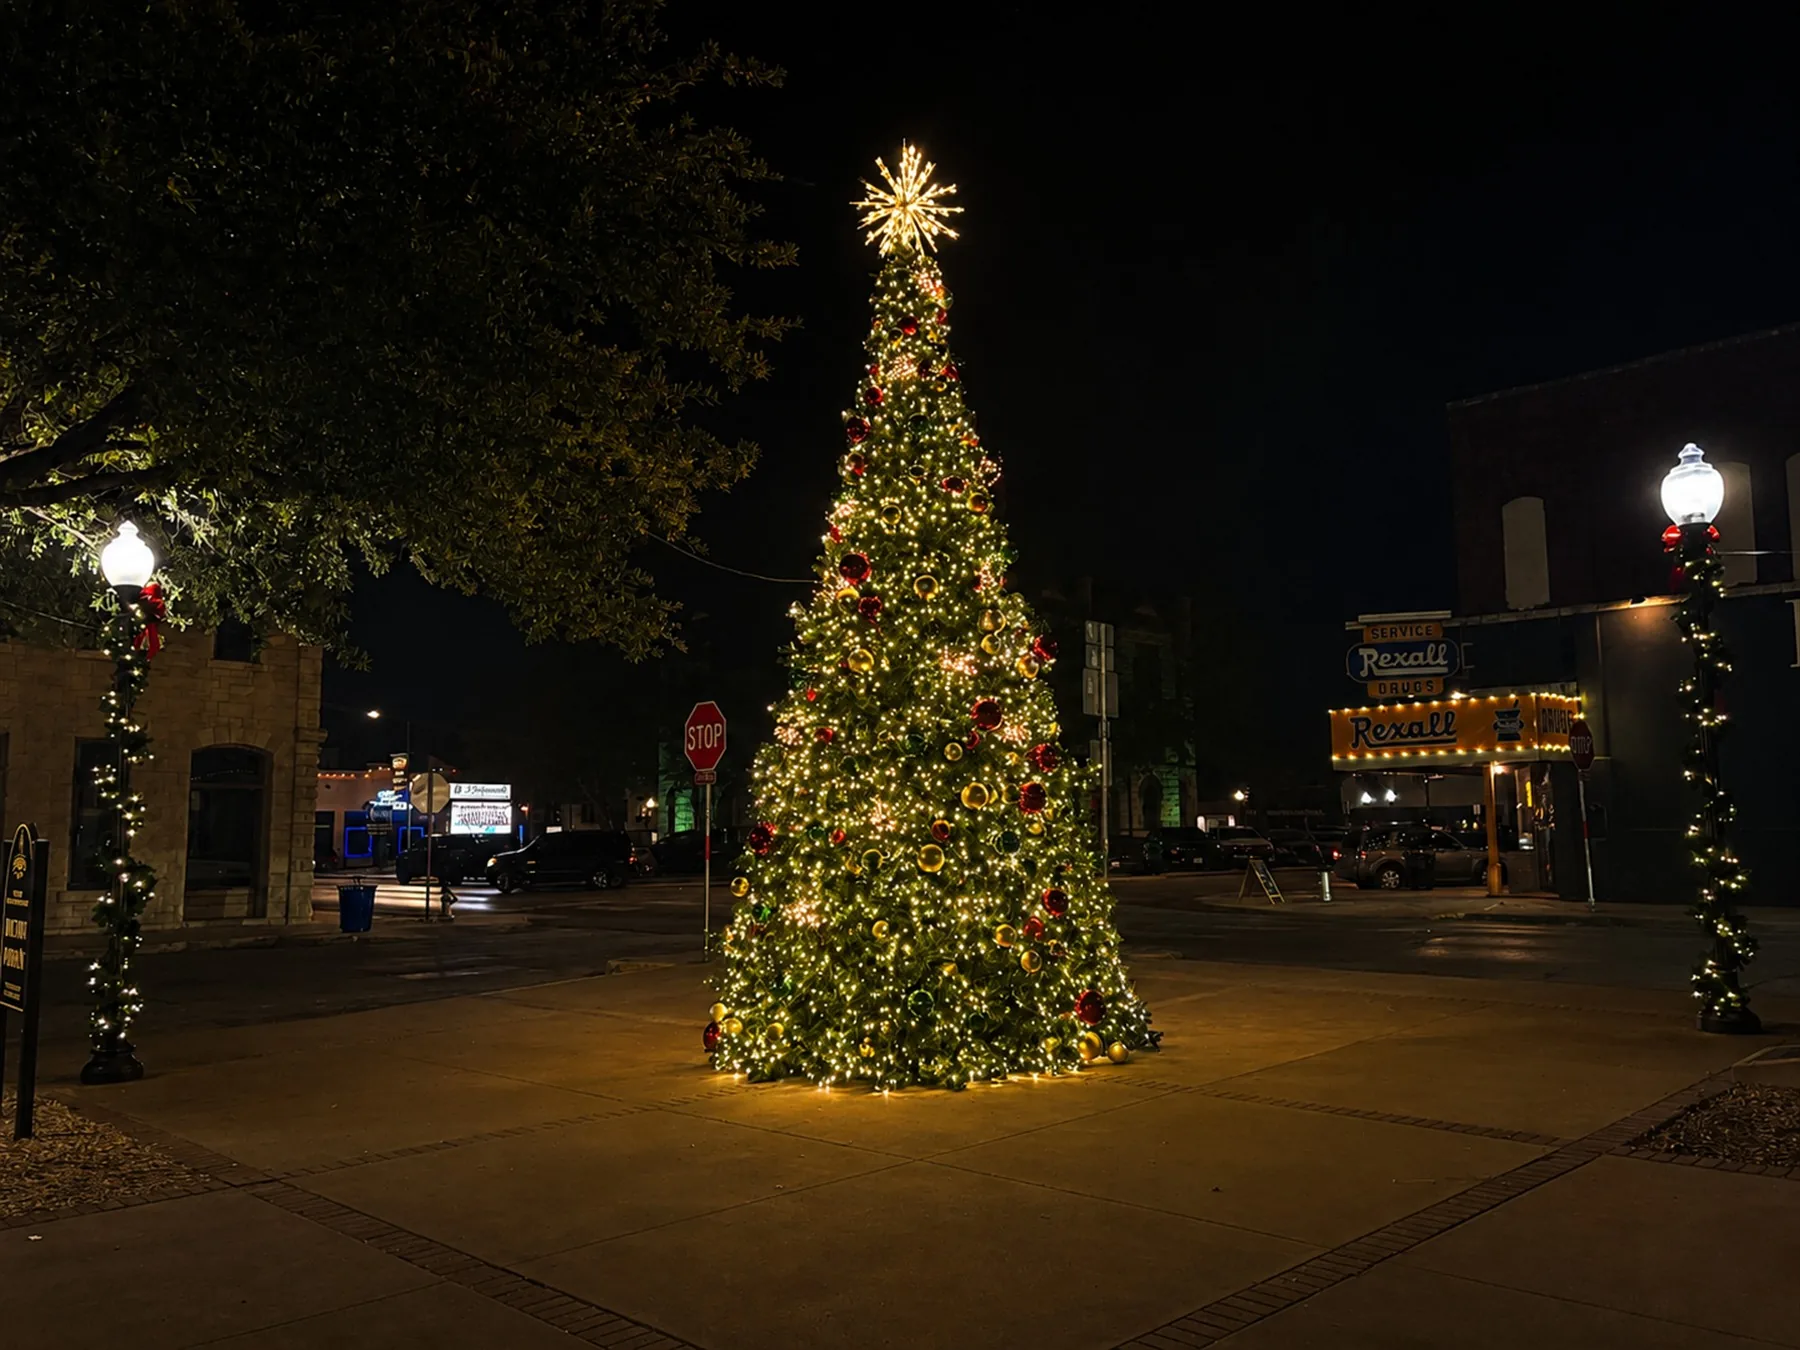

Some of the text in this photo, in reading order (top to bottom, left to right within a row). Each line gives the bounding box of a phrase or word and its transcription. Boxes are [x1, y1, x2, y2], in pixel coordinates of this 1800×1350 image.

[1371, 625, 1433, 640] SERVICE
[1358, 643, 1449, 677] Rexall
[1378, 680, 1435, 695] DRUGS
[687, 723, 722, 751] STOP
[1348, 710, 1458, 750] Rexall
